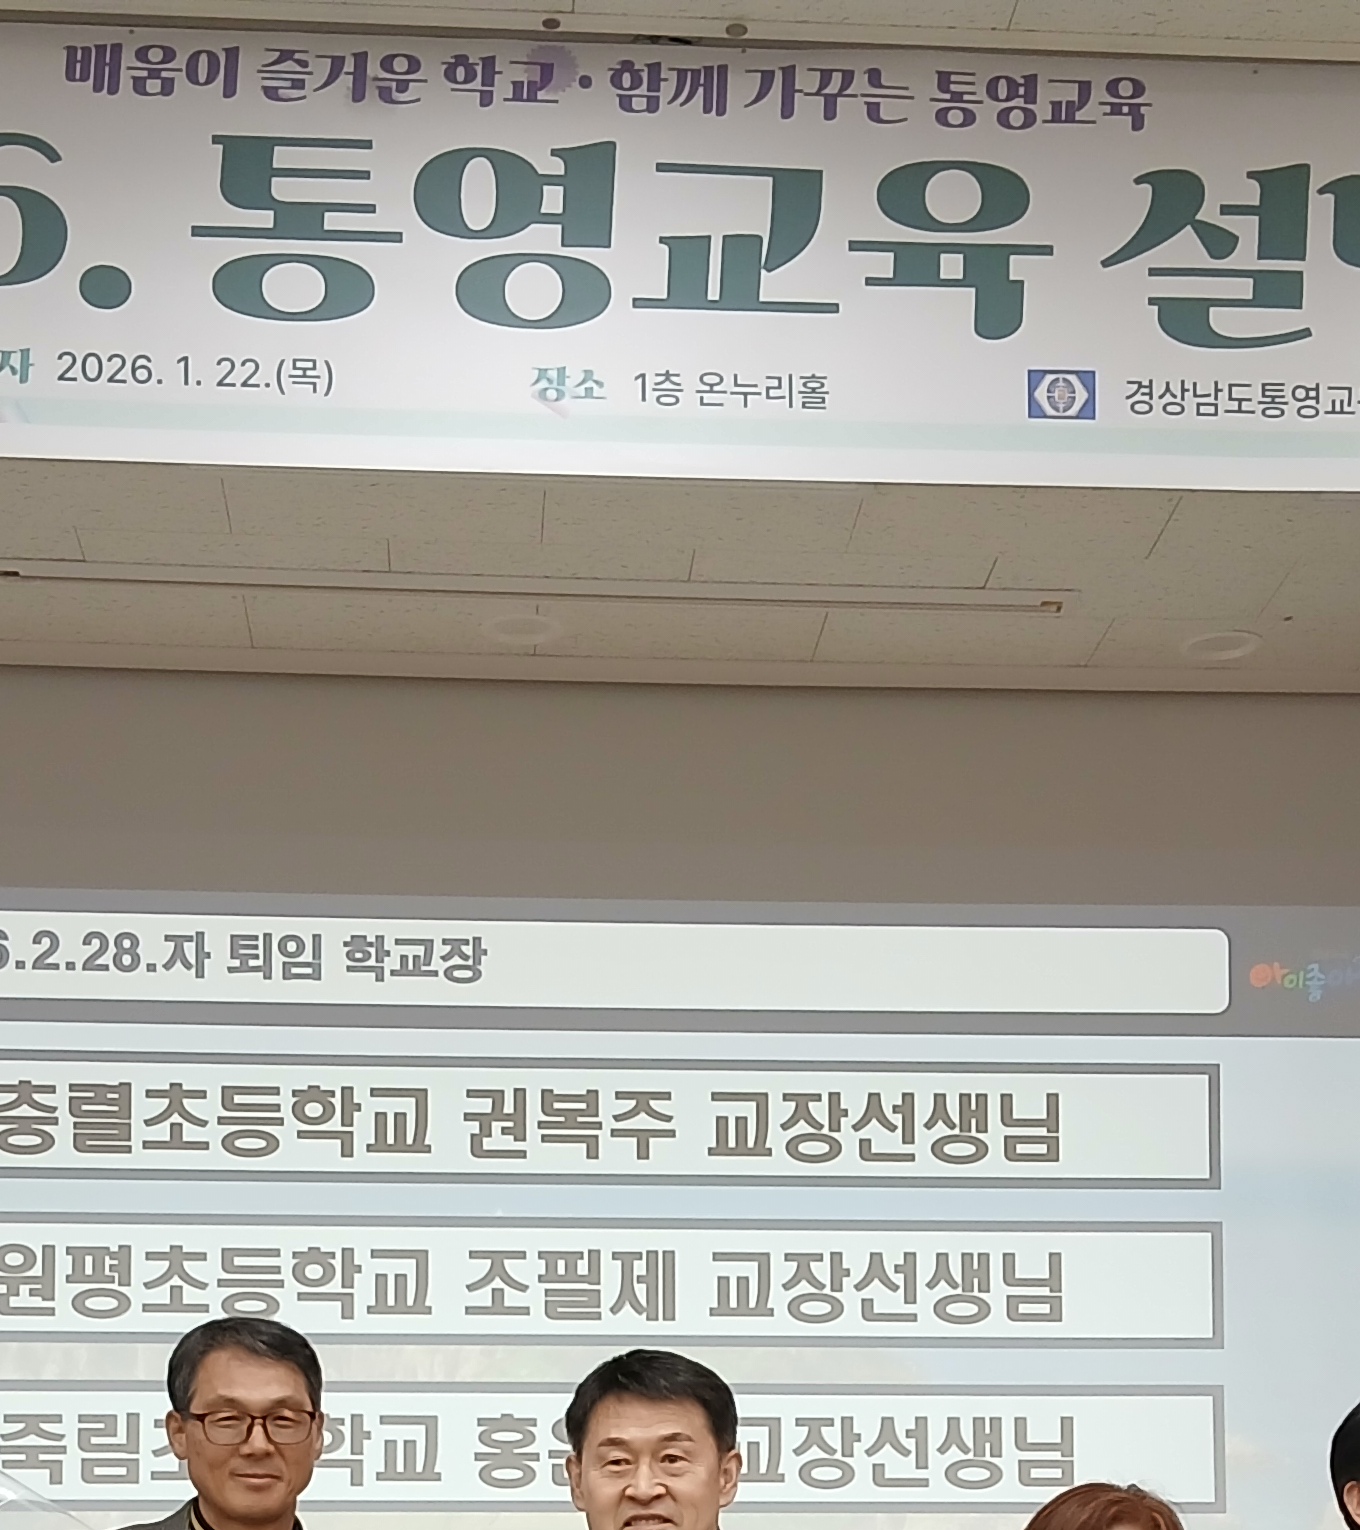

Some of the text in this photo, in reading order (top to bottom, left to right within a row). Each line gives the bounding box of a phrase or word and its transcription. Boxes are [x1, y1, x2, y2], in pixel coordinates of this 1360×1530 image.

[64, 42, 238, 99] 배움이
[257, 48, 428, 106] 즐거운
[744, 65, 915, 125] 가꾸는
[928, 77, 1154, 132] 통영교육
[191, 133, 1055, 341] 통영교육
[531, 366, 830, 411] 장소 1층 온누리홀
[228, 933, 323, 981] 퇴임
[343, 935, 488, 984] 학교장
[464, 1088, 677, 1161] 권복주
[708, 1091, 1061, 1165] 교장선생님
[465, 1249, 677, 1324] 조필제
[709, 1253, 1064, 1325] 교장선생님
